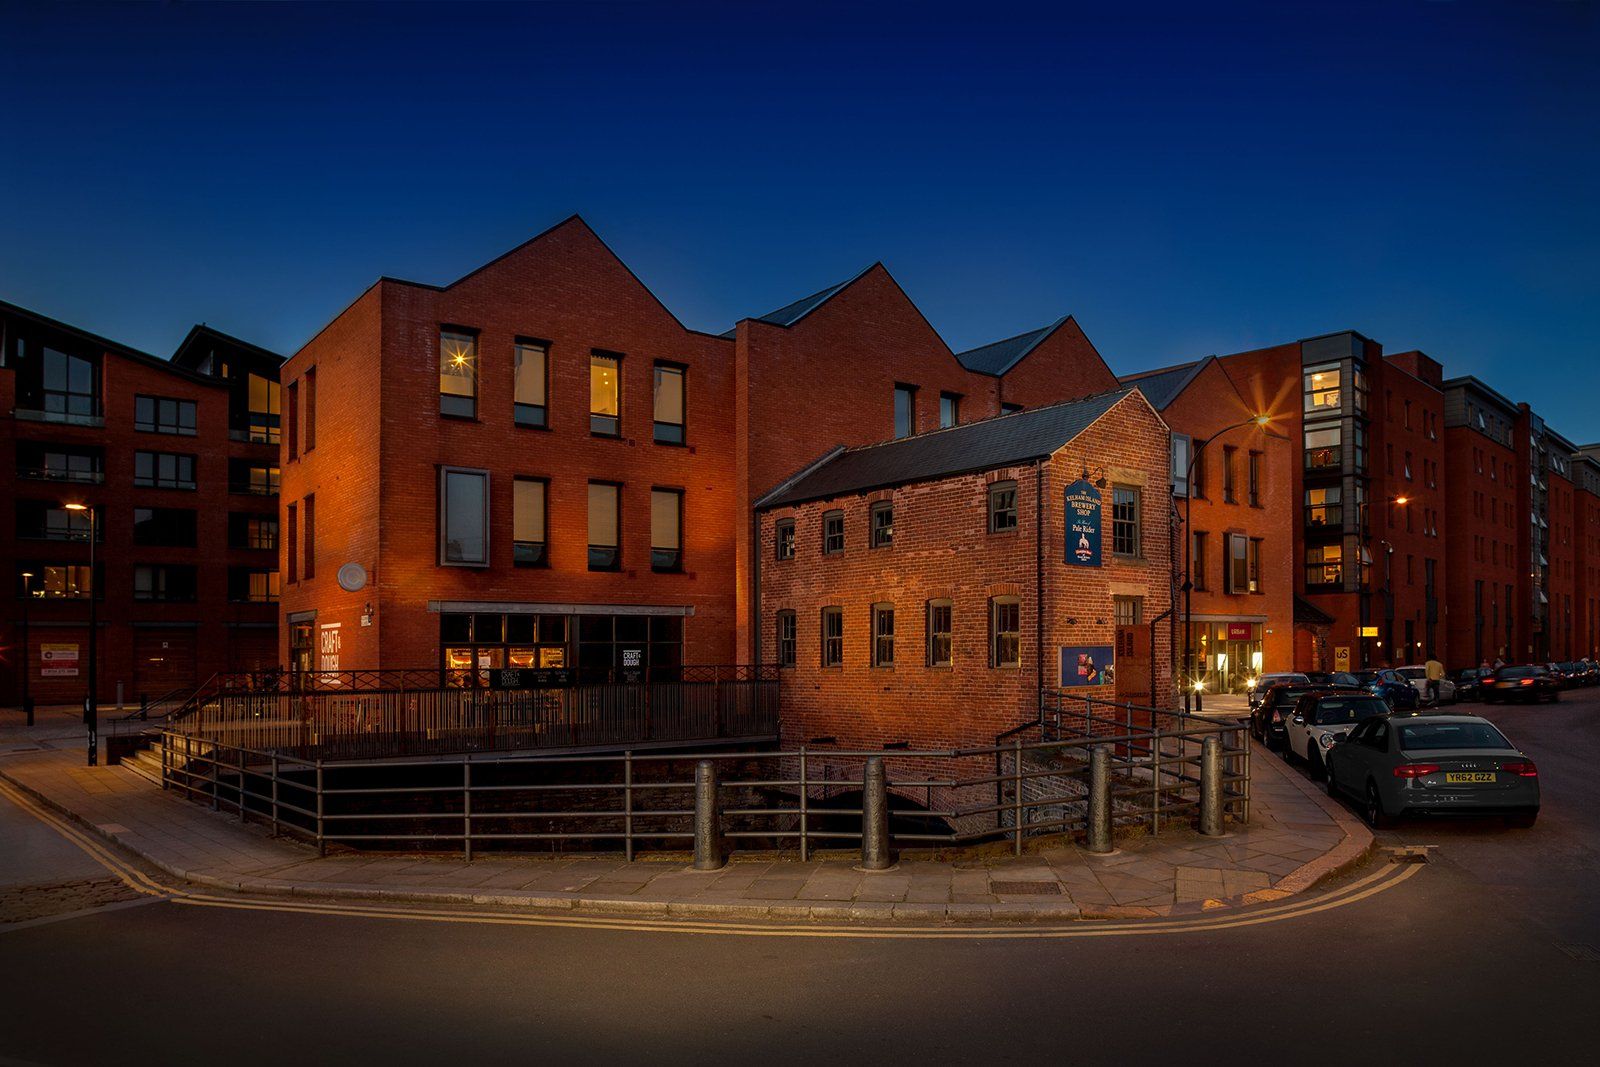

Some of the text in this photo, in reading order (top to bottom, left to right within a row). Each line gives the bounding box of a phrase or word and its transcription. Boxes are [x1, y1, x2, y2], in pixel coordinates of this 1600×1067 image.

[1071, 501, 1096, 510] BREWERY
[1072, 524, 1095, 534] Pale Rider
[321, 630, 338, 653] CRAFT
[623, 652, 639, 660] CRAFT
[623, 659, 640, 667] DOUGH
[1450, 773, 1492, 781] YR62 GZZ
